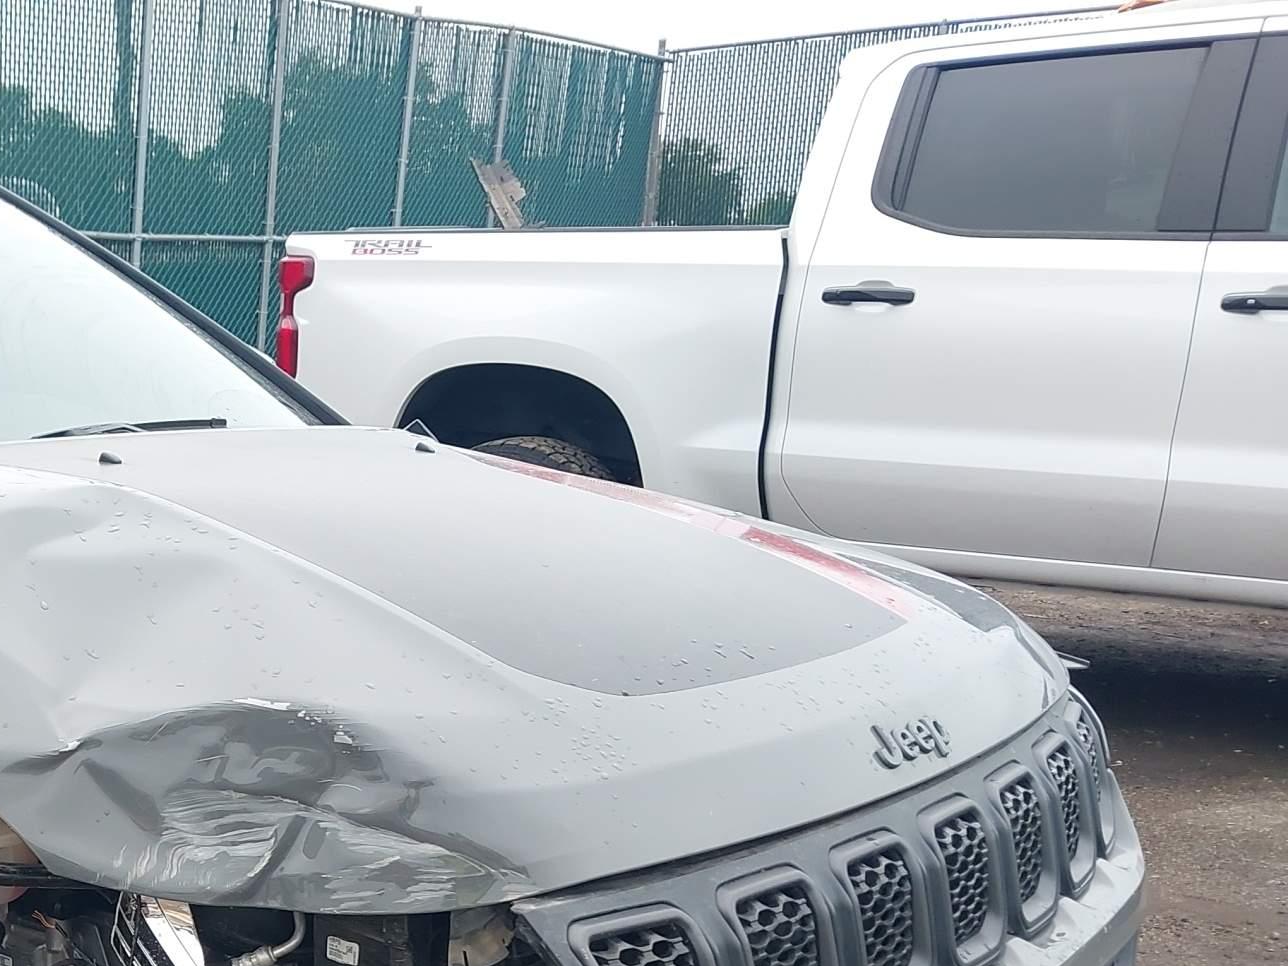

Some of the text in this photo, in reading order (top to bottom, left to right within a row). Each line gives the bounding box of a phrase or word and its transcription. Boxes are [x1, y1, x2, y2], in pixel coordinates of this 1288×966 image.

[344, 239, 433, 248] TRAIL
[351, 248, 419, 256] BOSS
[869, 718, 952, 770] Jeep
